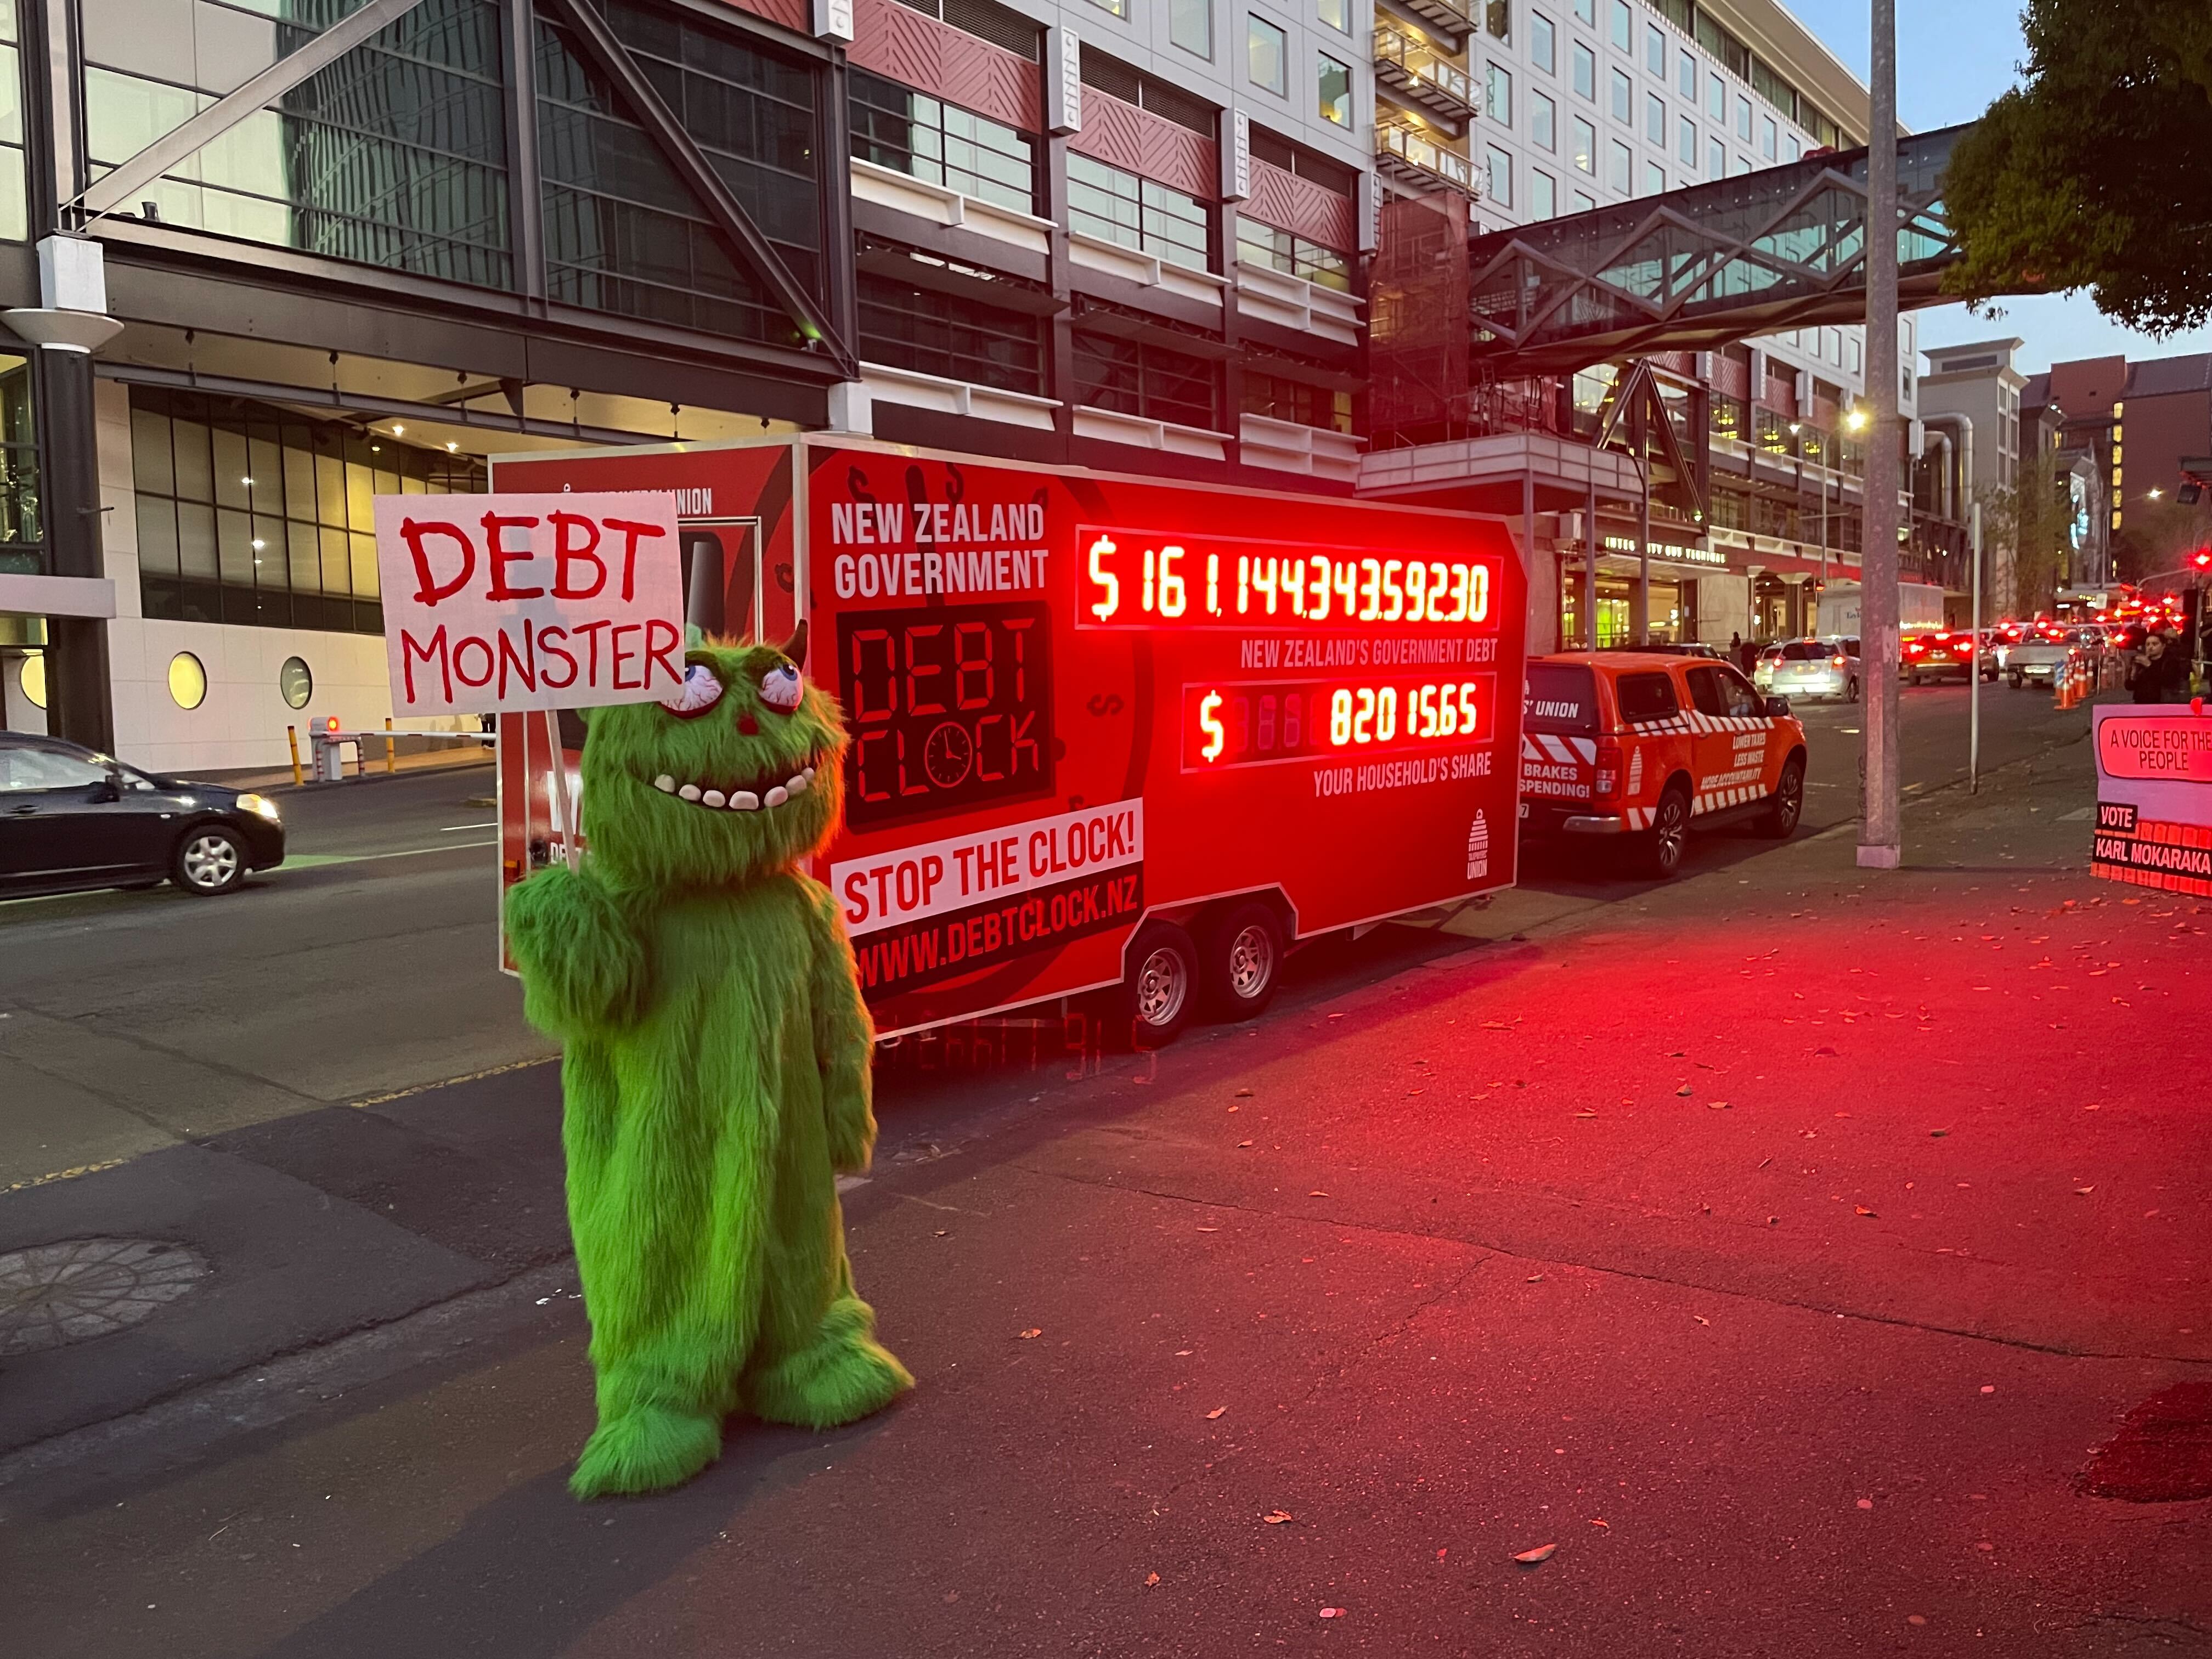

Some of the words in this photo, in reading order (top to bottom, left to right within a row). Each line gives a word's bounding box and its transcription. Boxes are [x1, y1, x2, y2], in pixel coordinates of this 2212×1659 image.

[668, 488, 712, 515] NION
[832, 503, 904, 544] NEW
[914, 503, 1043, 543] ZEALAND
[400, 510, 666, 607] DEBT
[834, 549, 1048, 599] GOVERNMENT
[1088, 534, 1119, 622] $
[401, 618, 683, 703] MONSTER
[853, 618, 1036, 723] DEBT
[1241, 640, 1279, 669] NEW
[1283, 639, 1369, 667] ZEALAND'S
[1373, 639, 1463, 665] GOVERNMENT
[1466, 638, 1498, 663] DEBT
[1200, 690, 1224, 763] $
[1536, 701, 1578, 718] UNION
[857, 710, 1039, 802] CLOCK
[1733, 734, 1751, 750] LOWER
[1751, 732, 1766, 747] TAXES
[2111, 730, 2119, 748] A
[2121, 730, 2160, 748] VOICE
[2164, 730, 2188, 751] FOR
[2190, 731, 2212, 751] THE
[1313, 769, 1353, 798] YOUR
[1356, 760, 1448, 792] HOUSEHOLD'S
[1451, 752, 1492, 779] SHARE
[1524, 763, 1577, 781] BRAKES
[1734, 752, 1748, 768] LESS
[2140, 751, 2189, 771] PEOPLE
[1520, 778, 1590, 798] SPENDING!
[2101, 806, 2133, 828] VOTE
[844, 855, 944, 924] STOP
[953, 837, 1020, 896] THE
[1029, 810, 1135, 877] CLOCK!
[2096, 838, 2128, 862] KARL
[2131, 843, 2211, 874] MOKARAKA
[856, 875, 1138, 990] WWW.DEBTCLOCK.NZ
